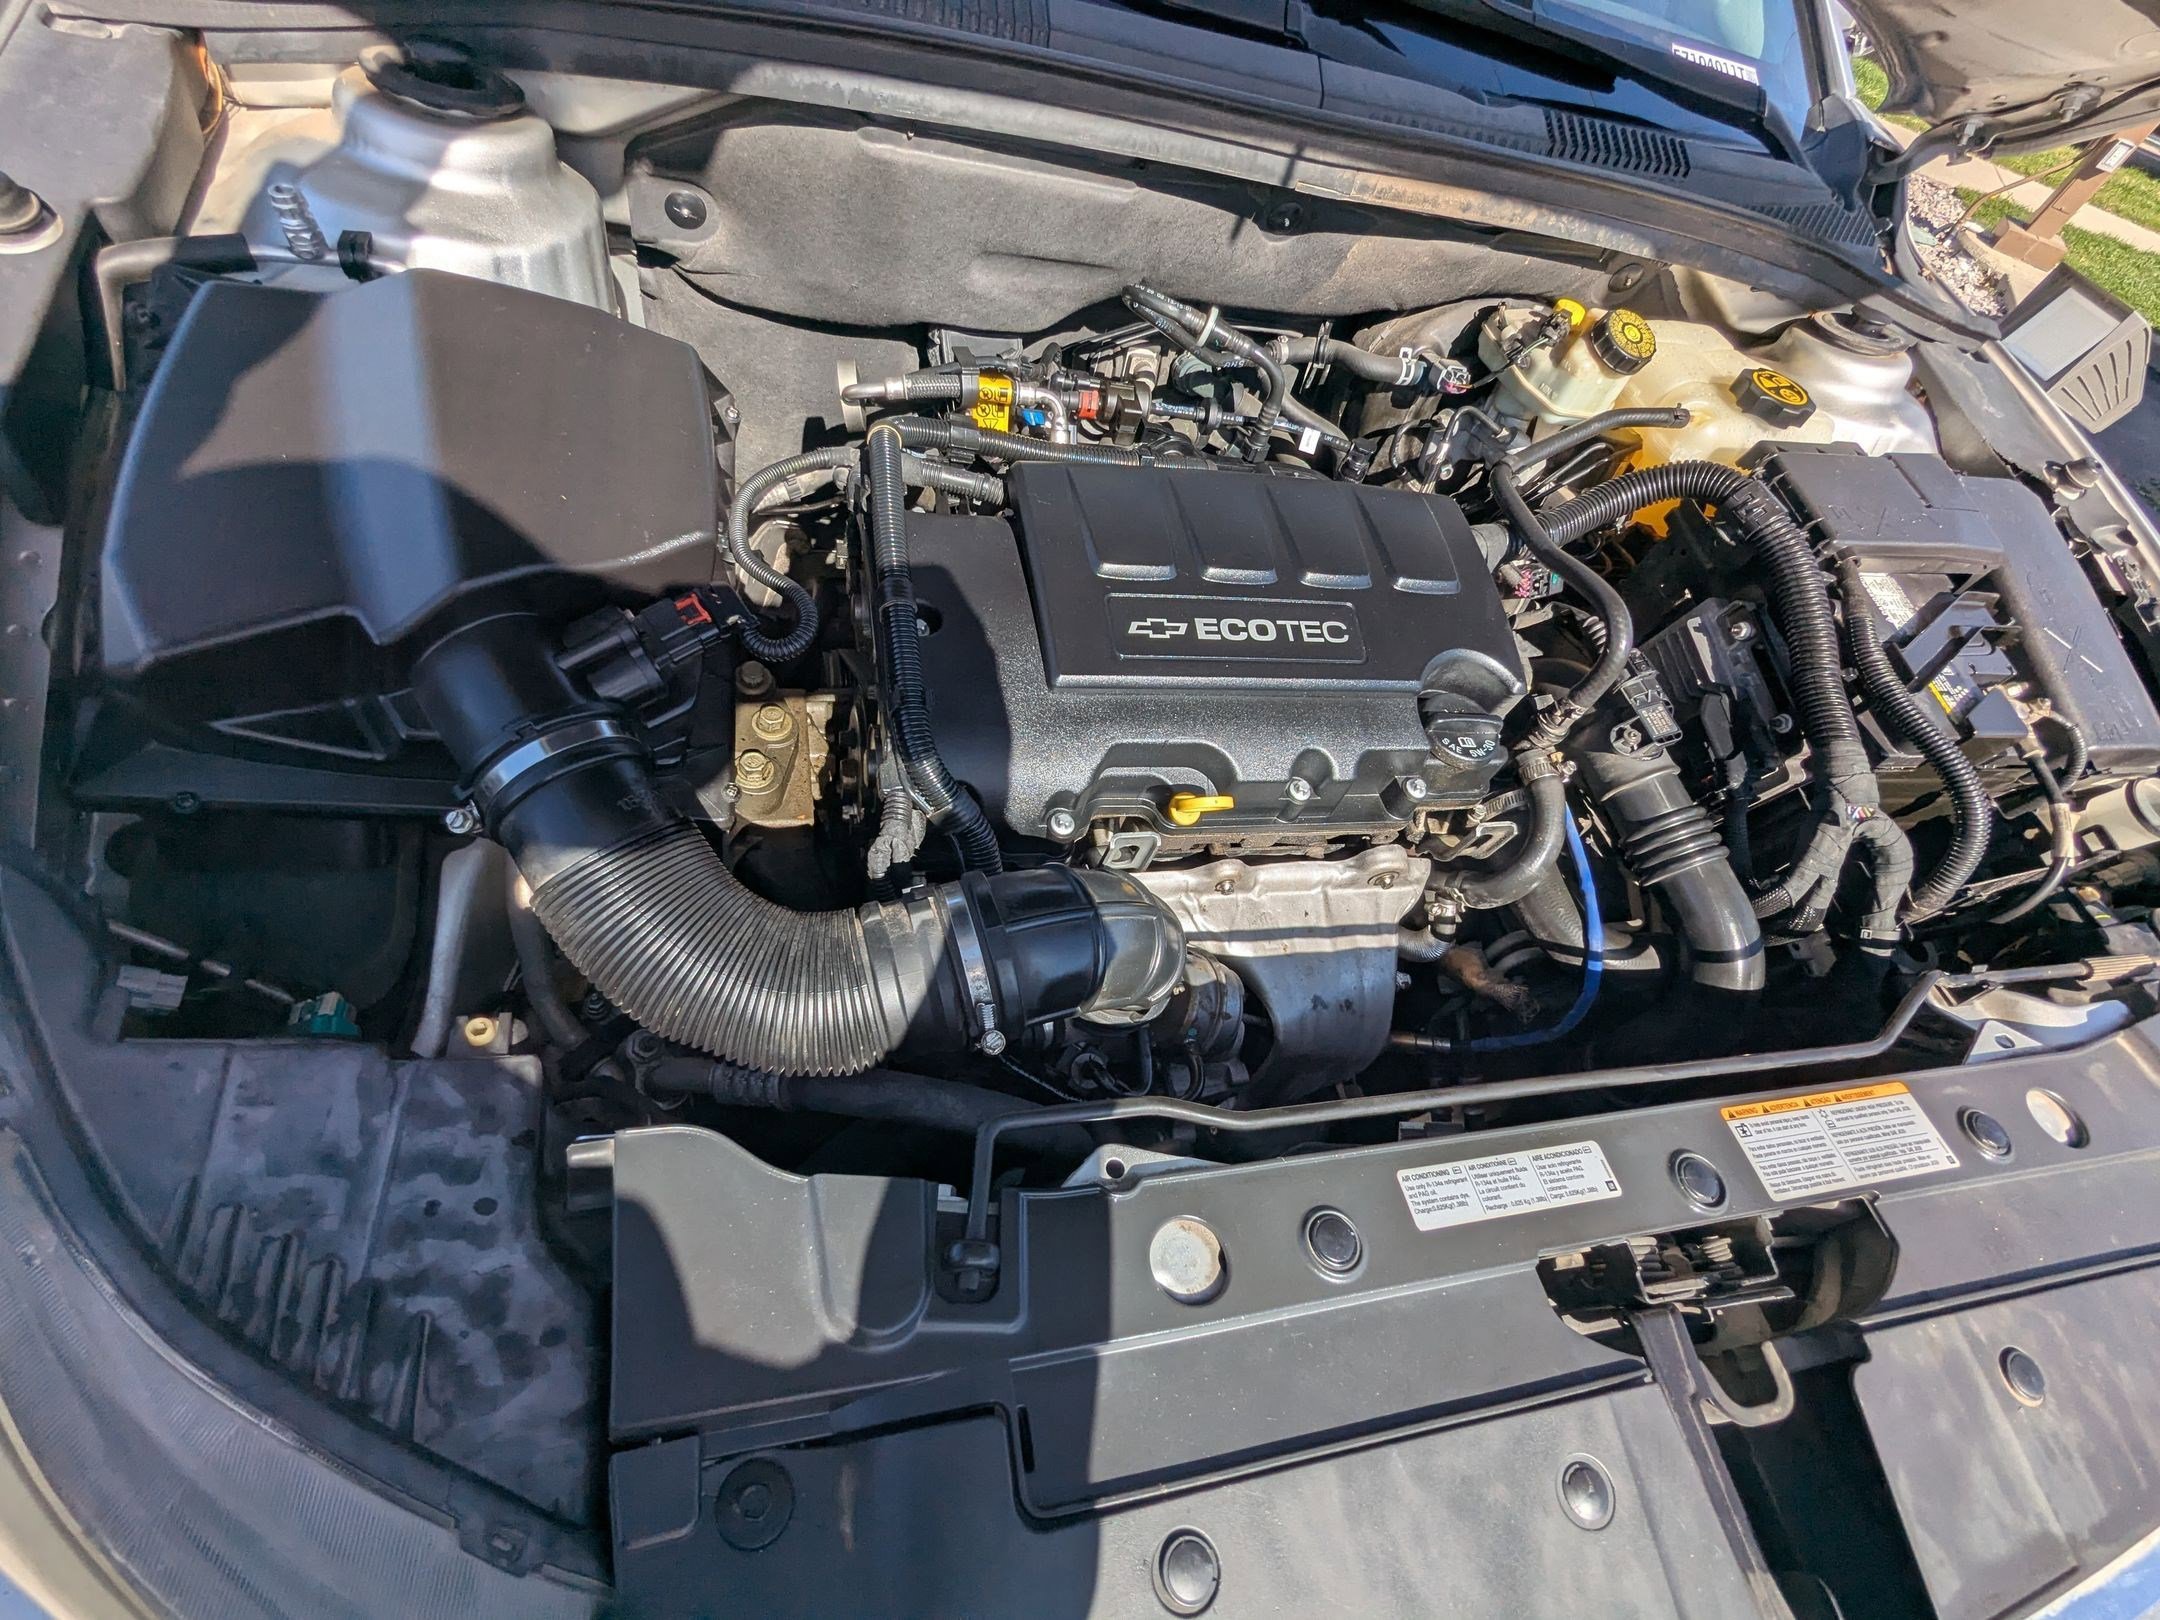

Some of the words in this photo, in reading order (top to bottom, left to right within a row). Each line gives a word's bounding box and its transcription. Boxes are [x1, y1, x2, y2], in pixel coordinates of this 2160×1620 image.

[1194, 617, 1350, 644] ECOTEC
[1441, 737, 1463, 754] SAE
[1469, 739, 1496, 758] 5W-30
[1411, 1169, 1450, 1181] CONDITIONING
